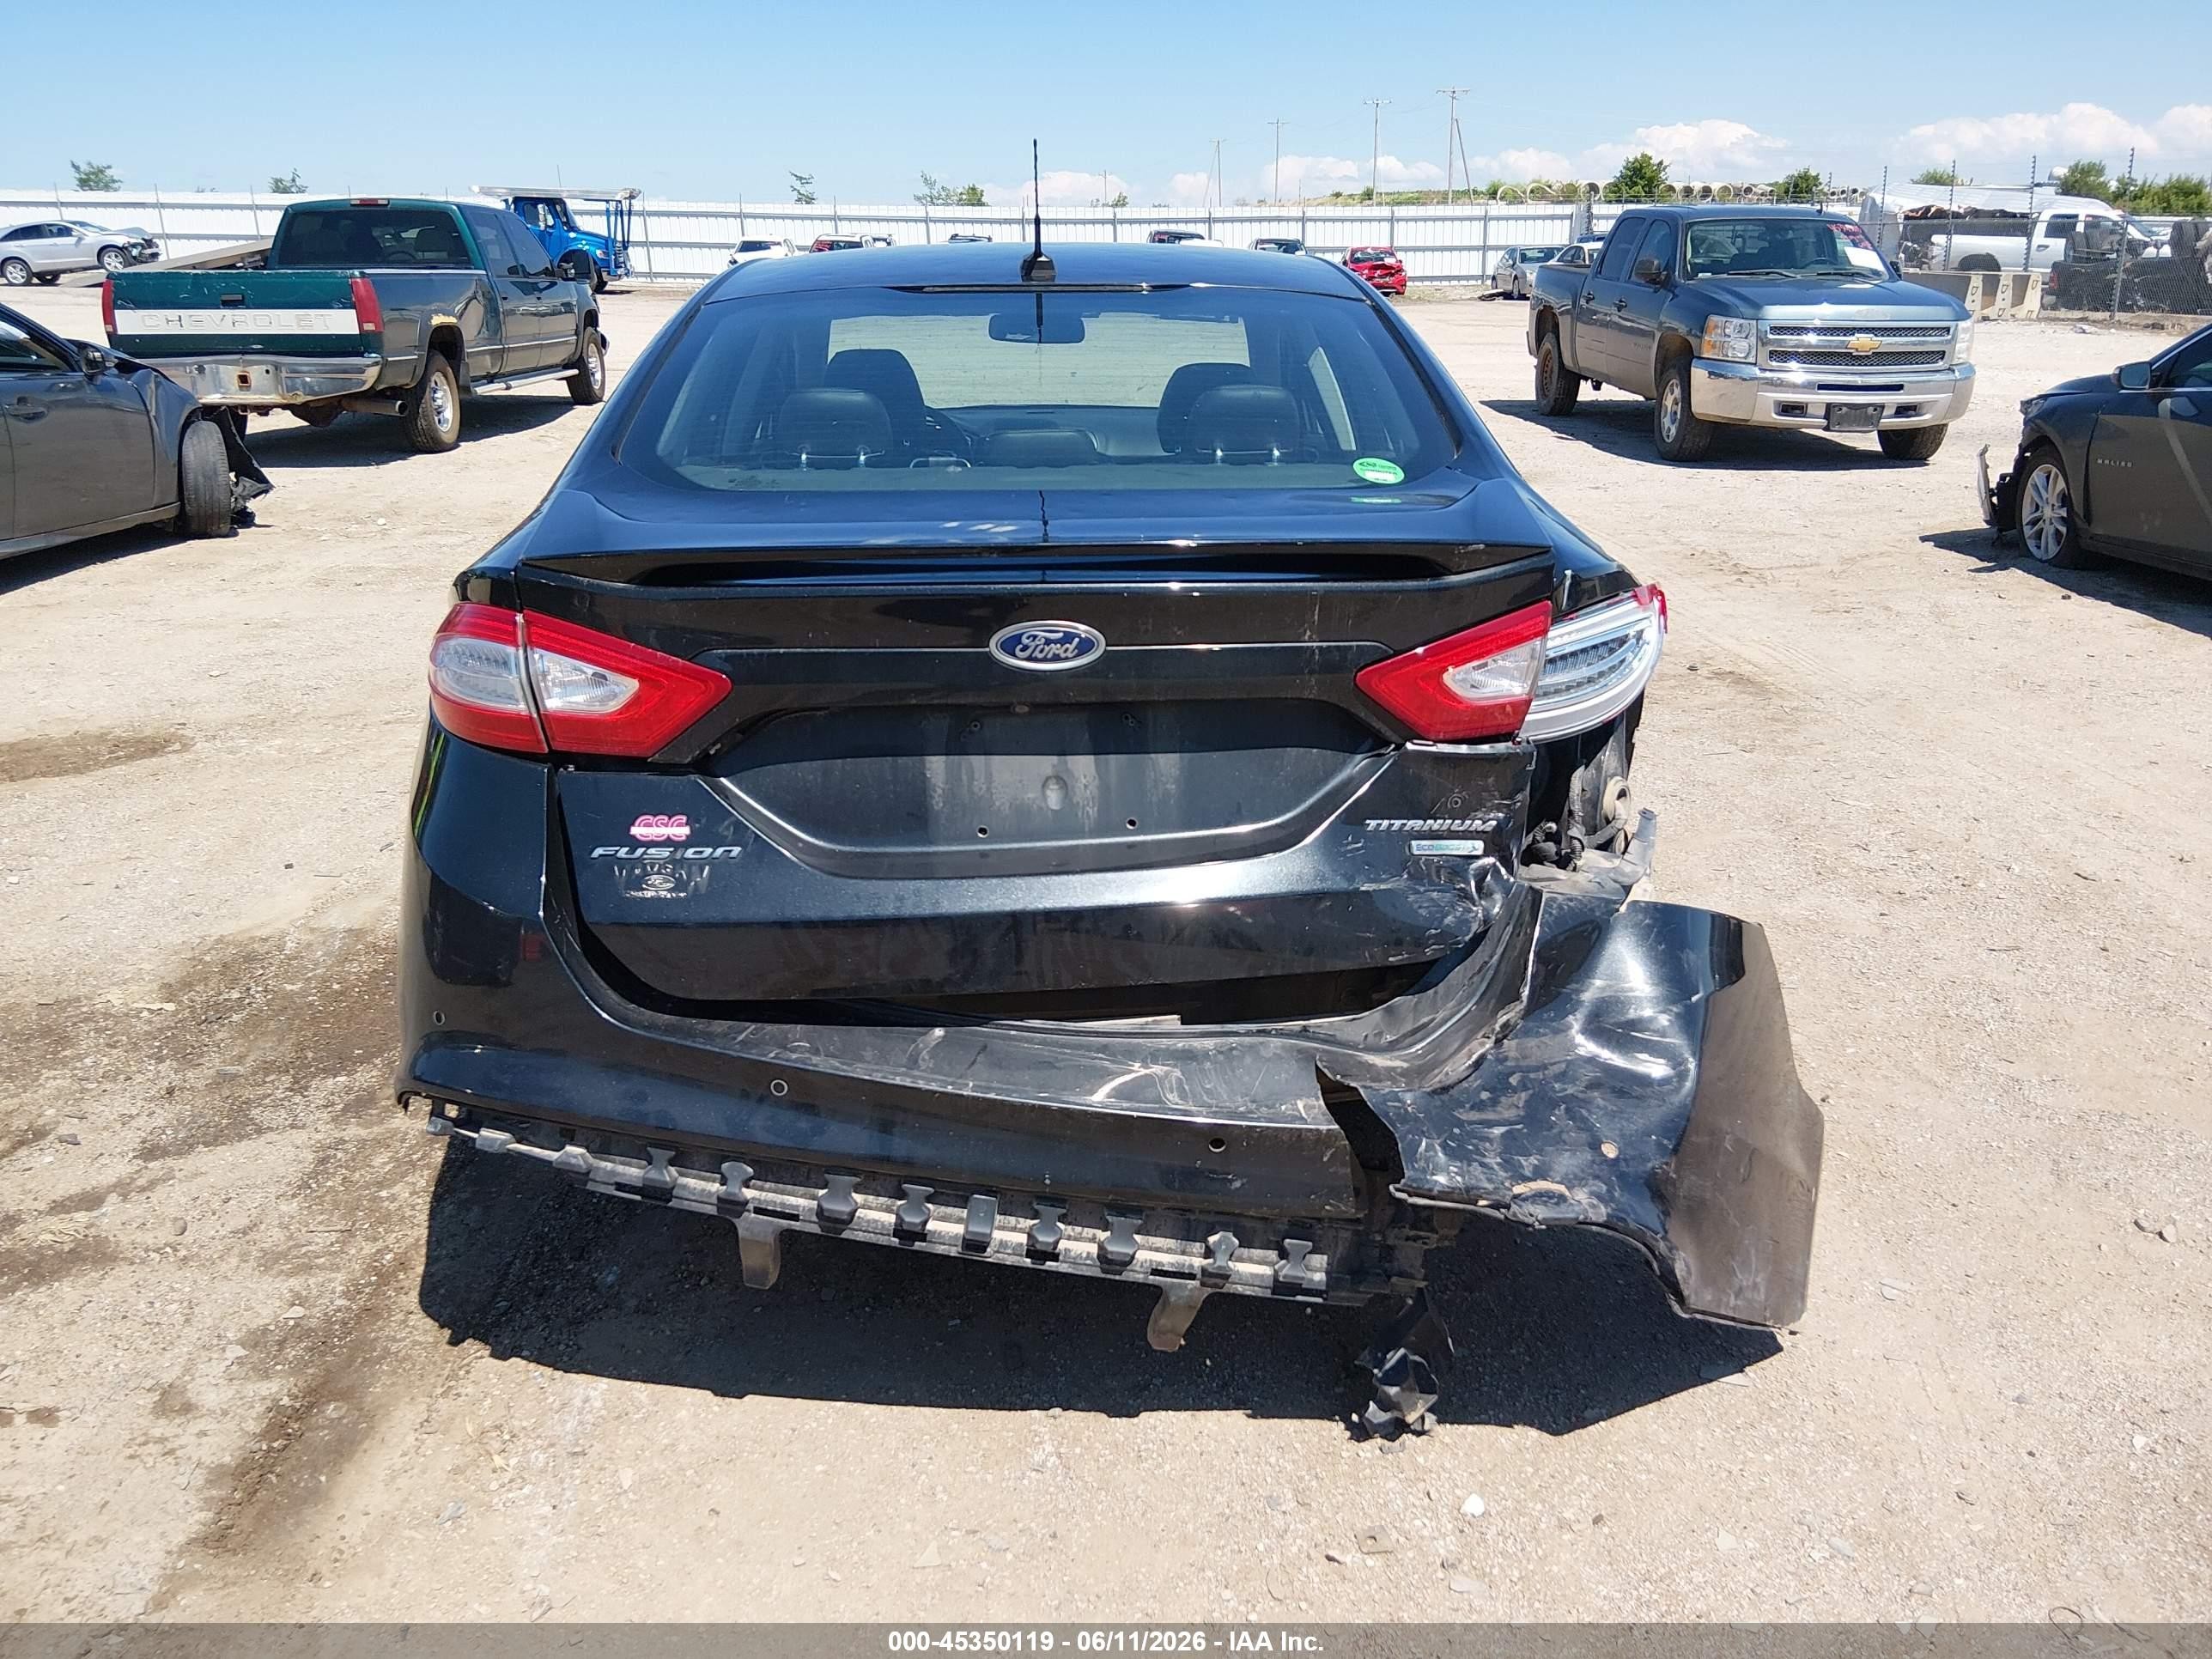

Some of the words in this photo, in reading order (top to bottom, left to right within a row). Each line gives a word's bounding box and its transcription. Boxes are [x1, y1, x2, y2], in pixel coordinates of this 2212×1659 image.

[140, 313, 335, 331] CHEVROLET
[1014, 630, 1080, 659] Ford
[1364, 818, 1498, 832] TITANIUM
[590, 845, 743, 860] FUSION
